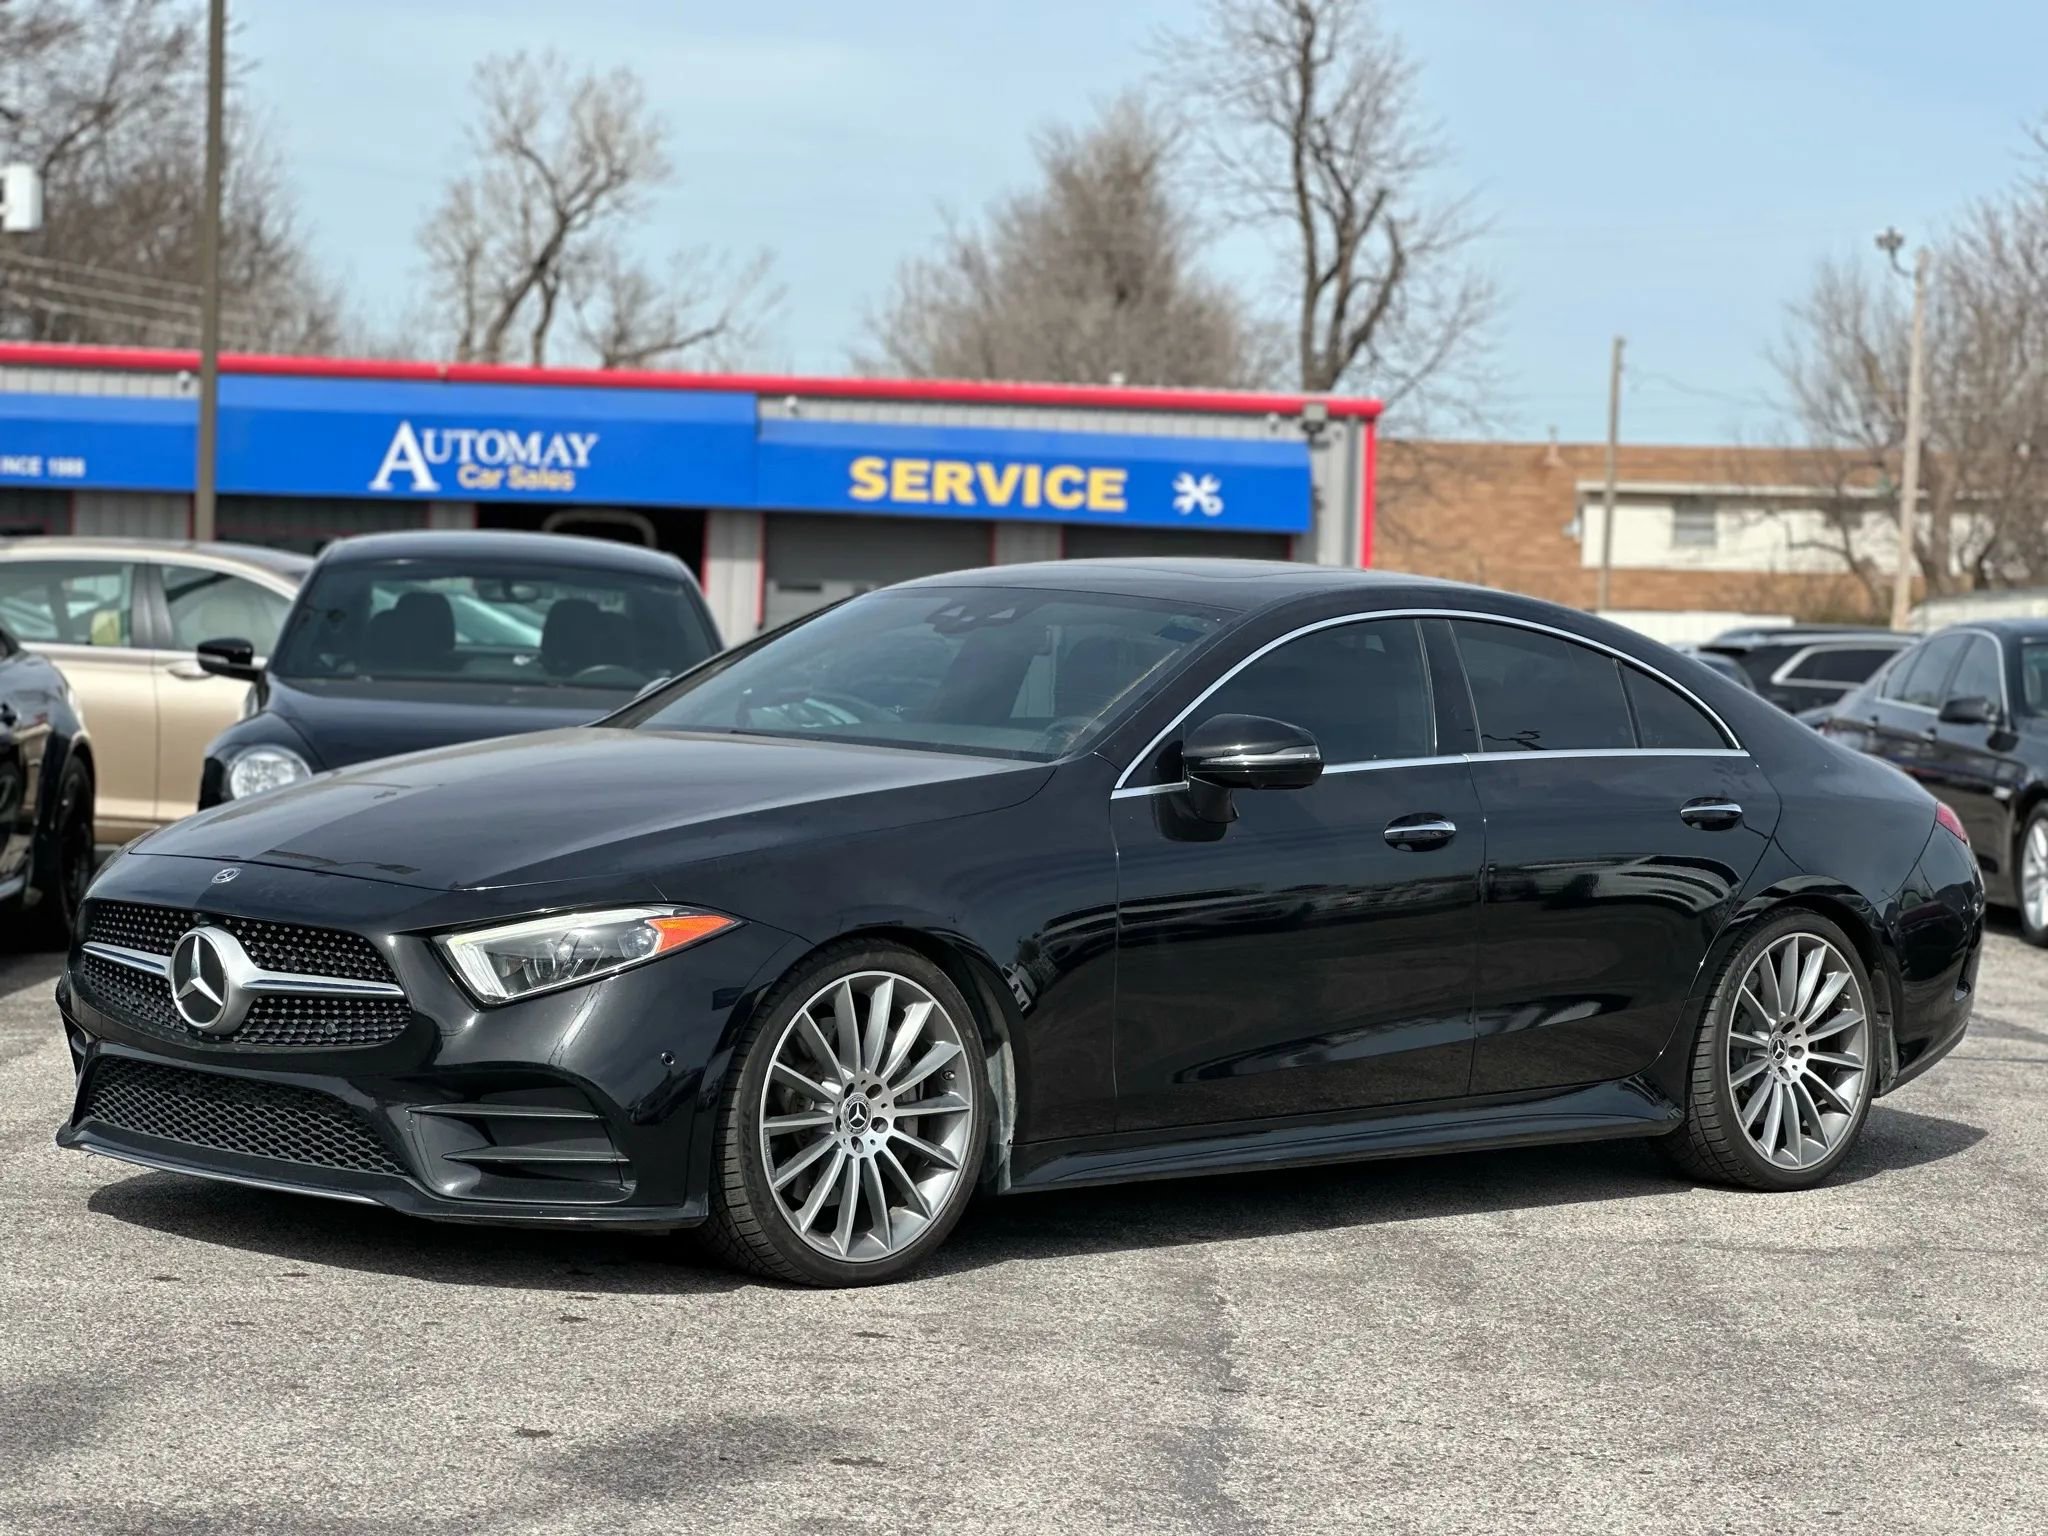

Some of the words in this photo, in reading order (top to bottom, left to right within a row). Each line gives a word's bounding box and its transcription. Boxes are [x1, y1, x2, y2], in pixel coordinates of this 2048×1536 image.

[368, 420, 598, 491] AUTOMAY
[457, 463, 505, 489] Car
[507, 465, 576, 492] Sales
[849, 456, 1128, 512] SERVICE
